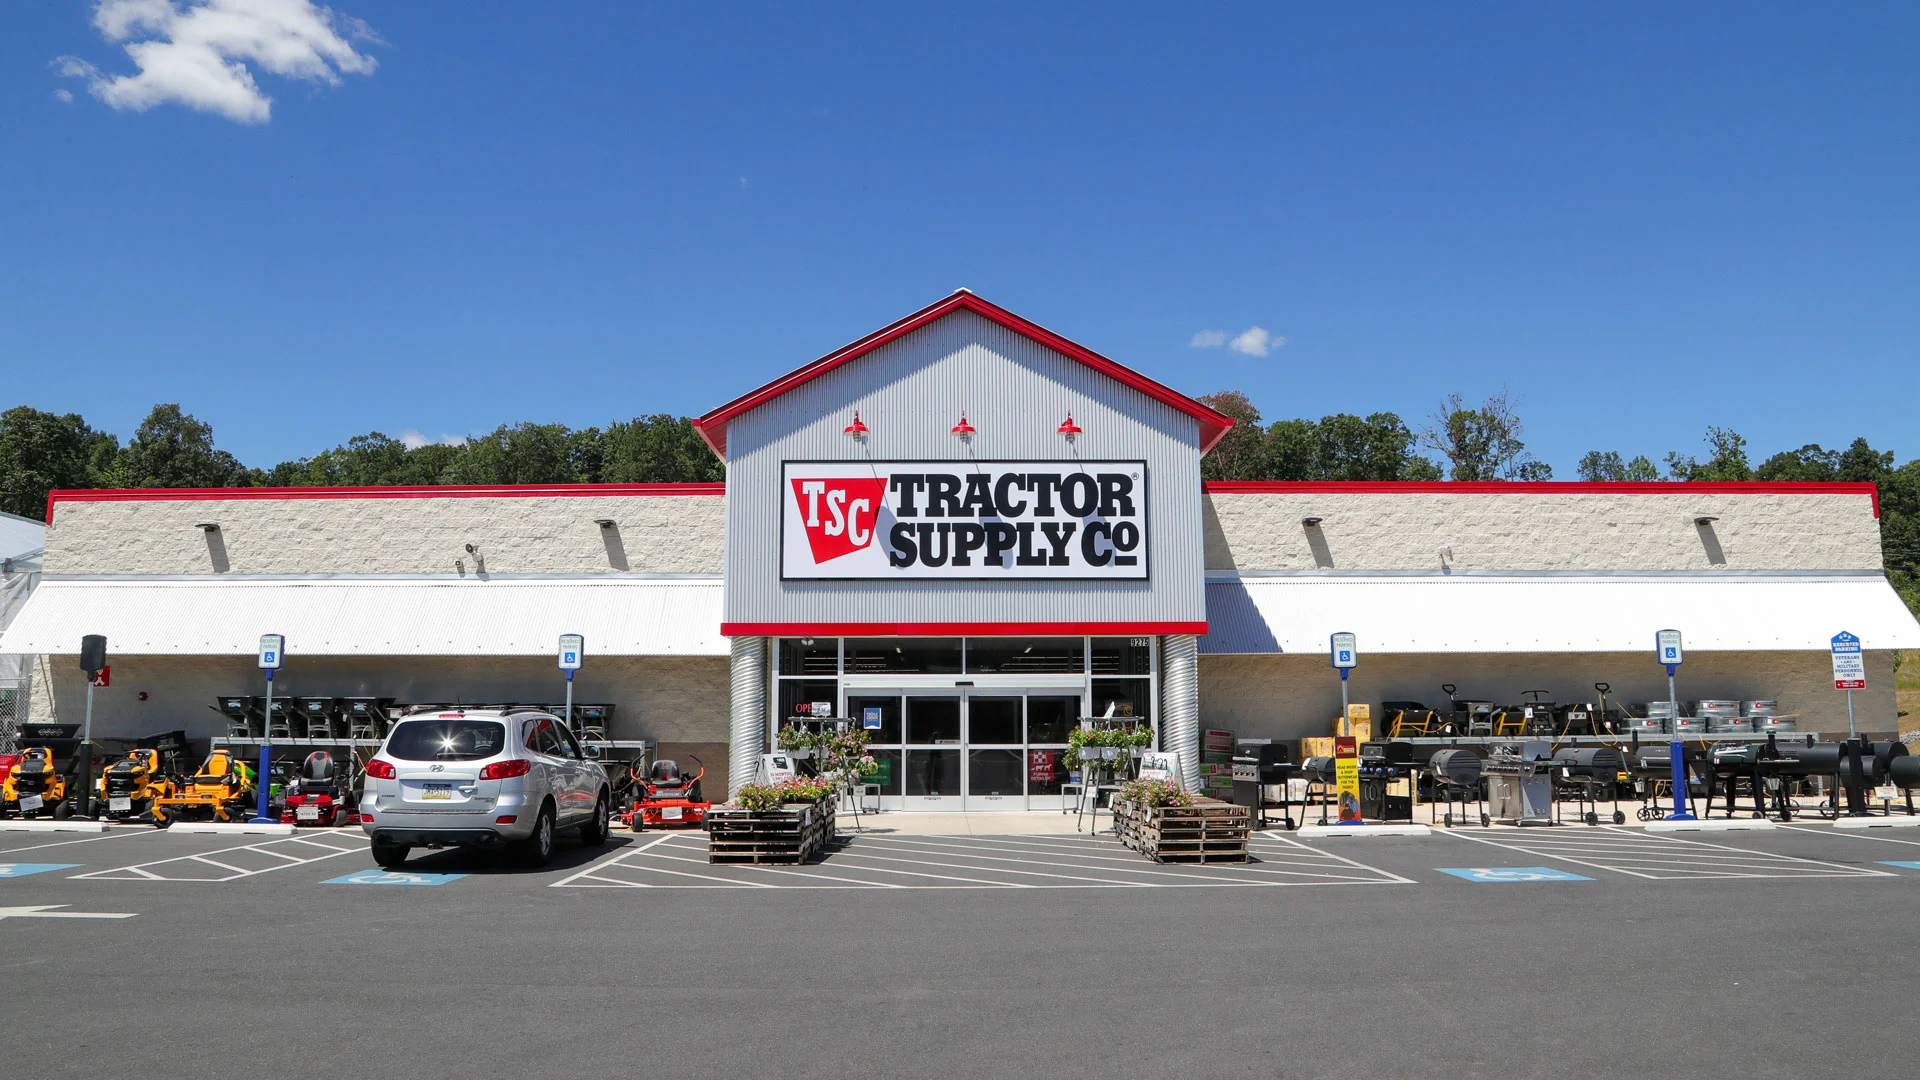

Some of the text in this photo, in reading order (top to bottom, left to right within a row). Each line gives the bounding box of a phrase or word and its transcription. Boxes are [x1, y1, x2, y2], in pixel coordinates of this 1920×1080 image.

[802, 481, 870, 547] TSC
[890, 472, 1136, 518] TRACTOR
[889, 521, 1077, 568] SUPPLY
[1130, 638, 1150, 647] 9275
[795, 703, 812, 713] OPE
